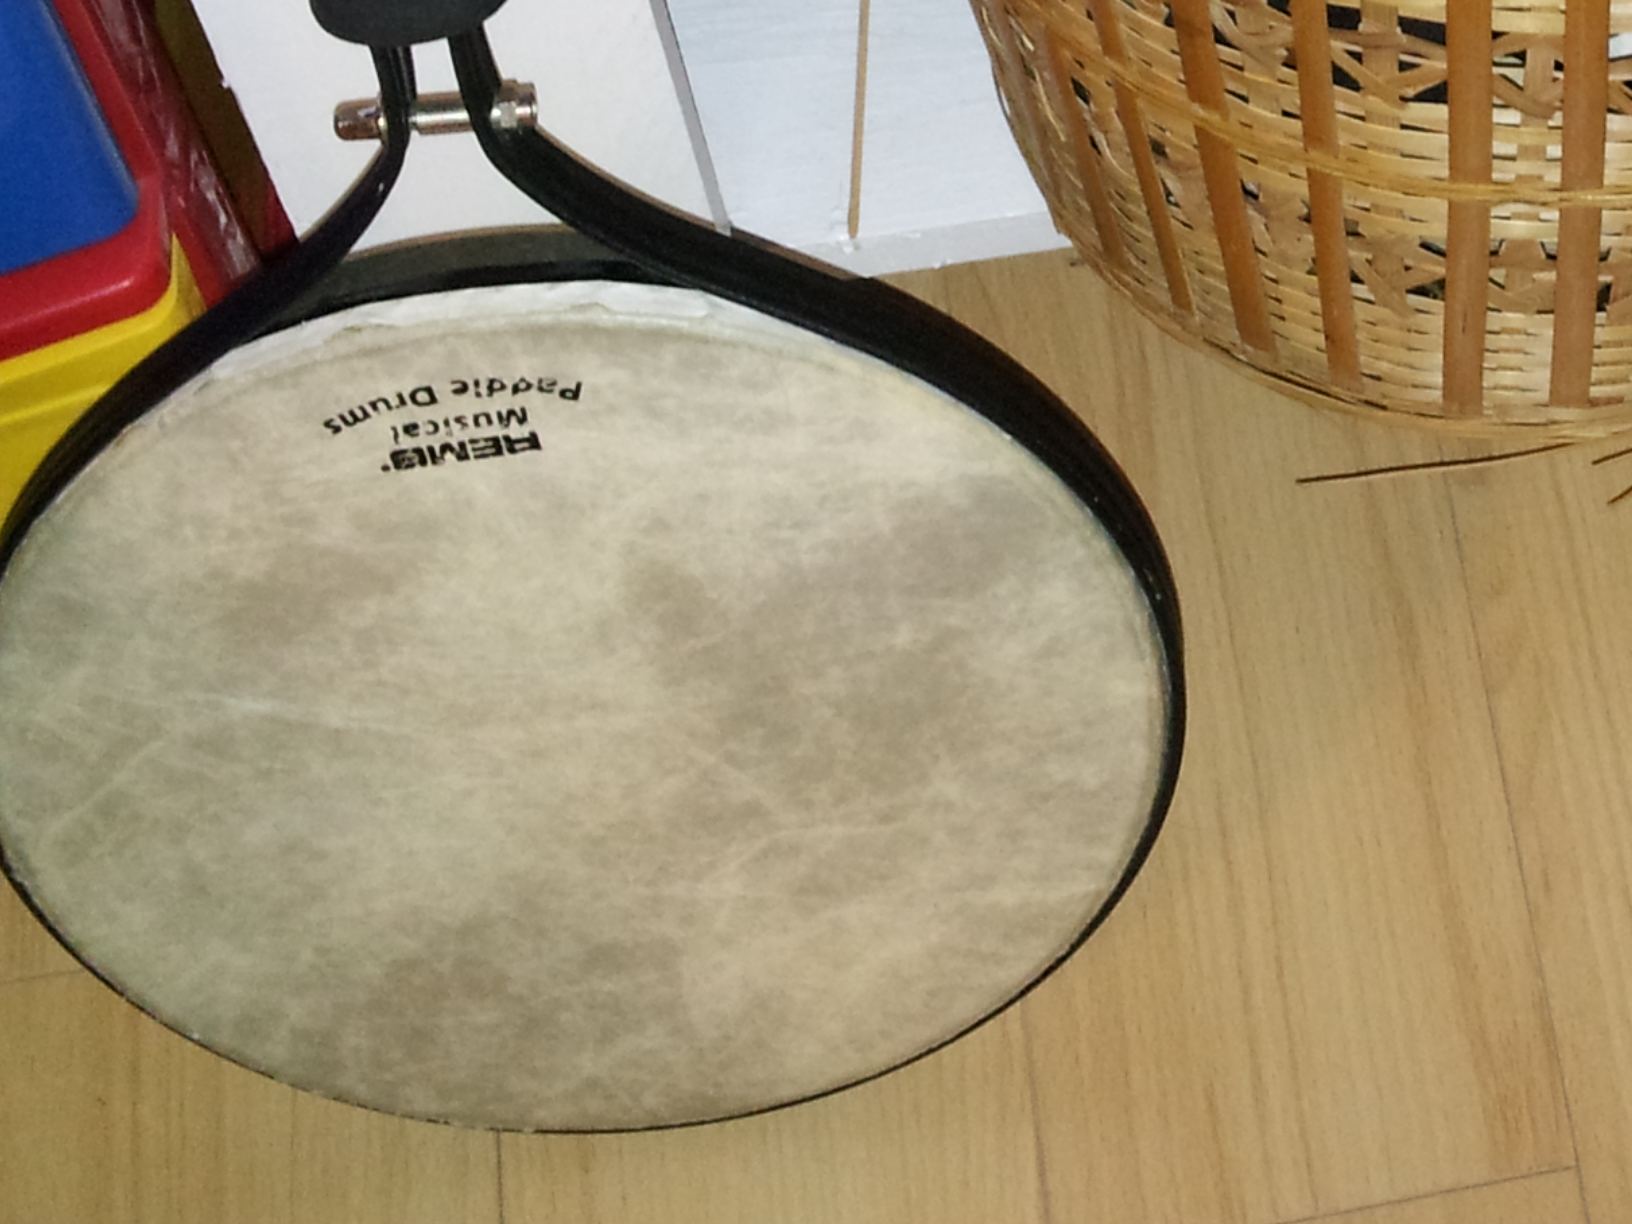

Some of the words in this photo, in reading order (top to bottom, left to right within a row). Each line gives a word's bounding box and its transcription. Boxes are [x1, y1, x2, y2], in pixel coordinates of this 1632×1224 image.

[450, 376, 583, 402] Paddle
[323, 385, 439, 436] Drums
[389, 406, 529, 444] Musical
